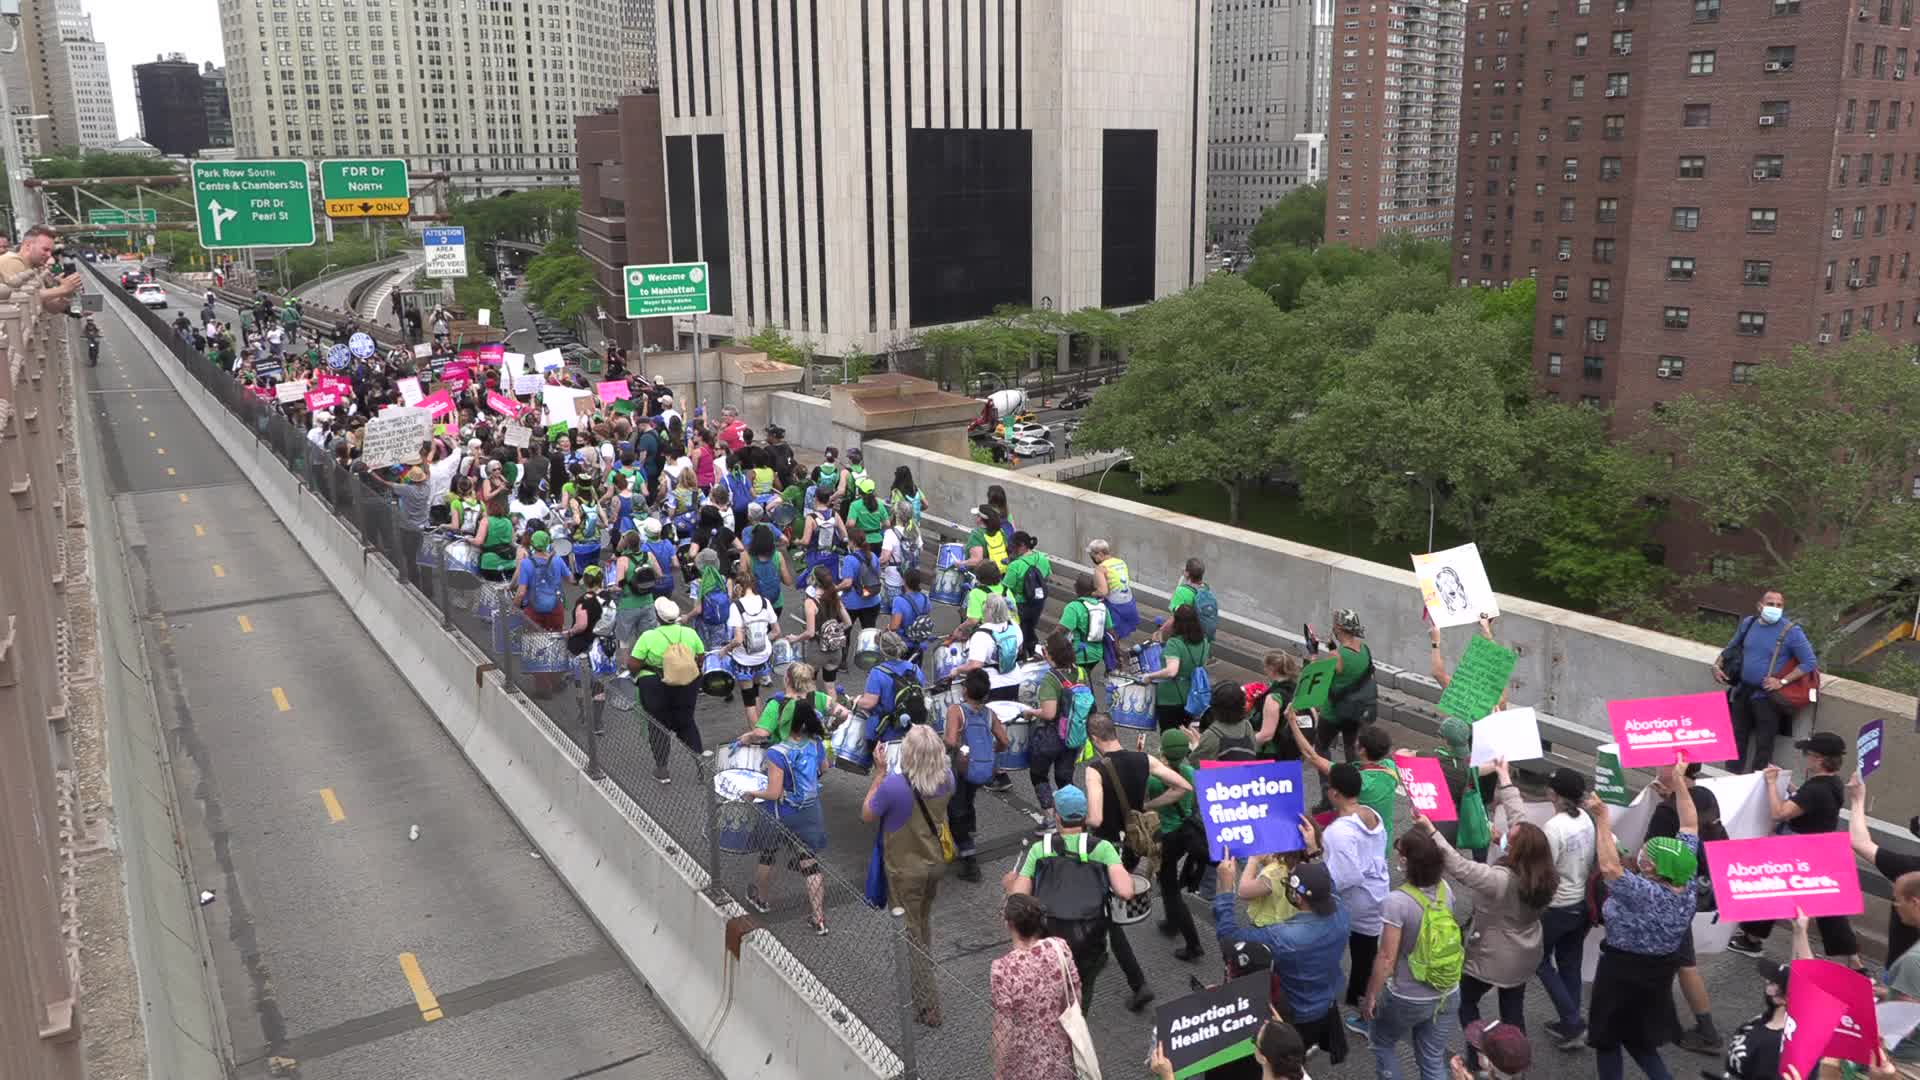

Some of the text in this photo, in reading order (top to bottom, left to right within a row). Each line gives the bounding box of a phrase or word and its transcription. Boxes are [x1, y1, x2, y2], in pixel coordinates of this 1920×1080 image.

[197, 168, 220, 178] Park
[223, 168, 245, 178] Row
[342, 166, 385, 177] FDR Dr
[199, 180, 304, 191] Centre & Chambers Sts
[348, 182, 383, 192] NORTH
[250, 199, 284, 208] FDR Dr
[331, 202, 402, 213] EXIT ONLY
[252, 211, 289, 221] Pearl St
[425, 229, 462, 237] ATTENTION
[648, 273, 685, 282] Welcome
[640, 286, 695, 296] to Manhattan
[1624, 715, 1693, 731] Abortion is
[1626, 728, 1717, 744] Health Care.
[1206, 776, 1293, 802] abortion
[1209, 801, 1269, 824] finder
[1216, 824, 1255, 844] .org
[1726, 859, 1810, 877] Abortion is
[1728, 875, 1839, 893] Health Care.
[1170, 997, 1250, 1034] Abortion is
[1171, 1014, 1258, 1050] Health Care.
